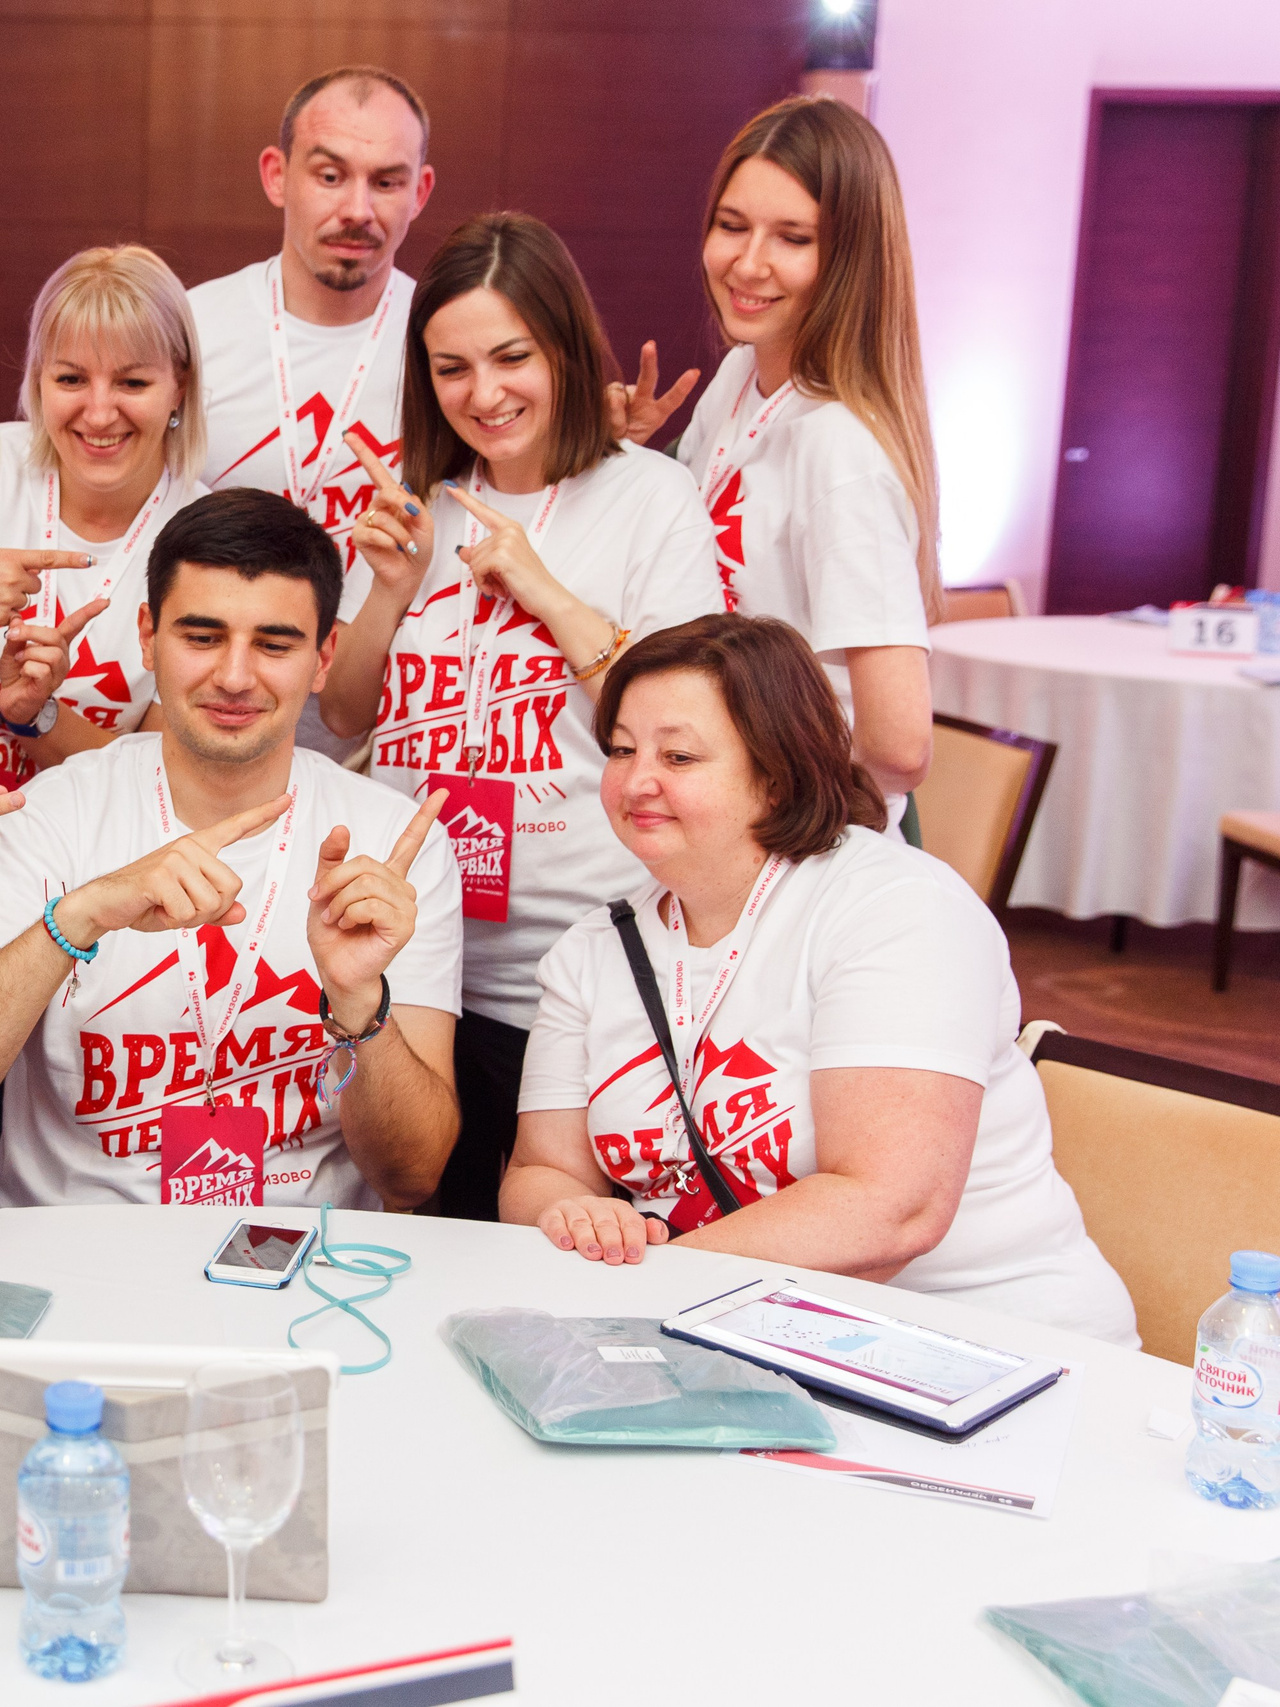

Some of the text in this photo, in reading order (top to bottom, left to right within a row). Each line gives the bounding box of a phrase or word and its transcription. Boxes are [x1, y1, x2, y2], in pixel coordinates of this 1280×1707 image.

[1194, 619, 1236, 647] 16
[156, 780, 171, 834] ЧЕРКИЗОВО
[514, 821, 566, 834] ИЗОВО
[449, 836, 505, 858] РЕМЯ
[460, 848, 505, 877] РВЫХ
[254, 881, 278, 935] ЧЕРКИЗОВО
[747, 861, 783, 917] ЧЕРКИЗОВО
[676, 960, 684, 1009] ЧЕРКИЗОВО
[698, 968, 731, 1025] ЧЕРКИЗОВО
[191, 988, 208, 1046] ЧЕРКИЗОВО
[216, 982, 243, 1037] ЧЕРКИЗОВО
[74, 1023, 329, 1116] ВРЕМЯ
[168, 1168, 255, 1205] ВРЕМЯ
[262, 1169, 312, 1186] ИЗОВО
[910, 1480, 998, 1500] ЧЕРКИЗОВО
